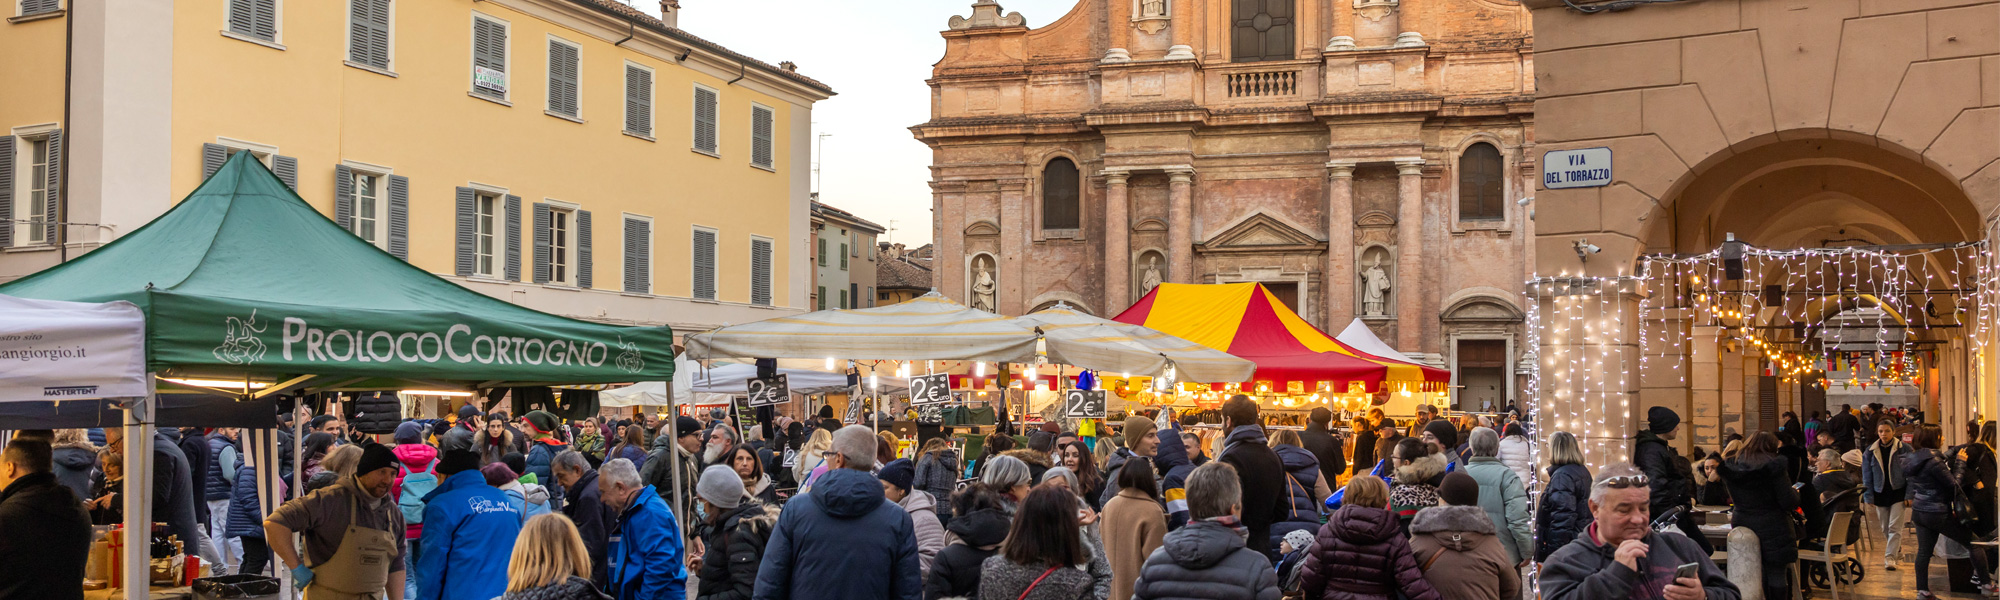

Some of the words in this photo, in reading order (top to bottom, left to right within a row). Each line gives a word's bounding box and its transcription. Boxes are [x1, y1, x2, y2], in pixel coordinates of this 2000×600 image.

[1568, 154, 1586, 166] VIA
[1546, 171, 1562, 183] DEL
[1565, 168, 1610, 182] TORRAZZO
[23, 332, 42, 341] sito
[0, 345, 87, 361] angiorgio.it
[44, 388, 97, 396] MASTERTENT
